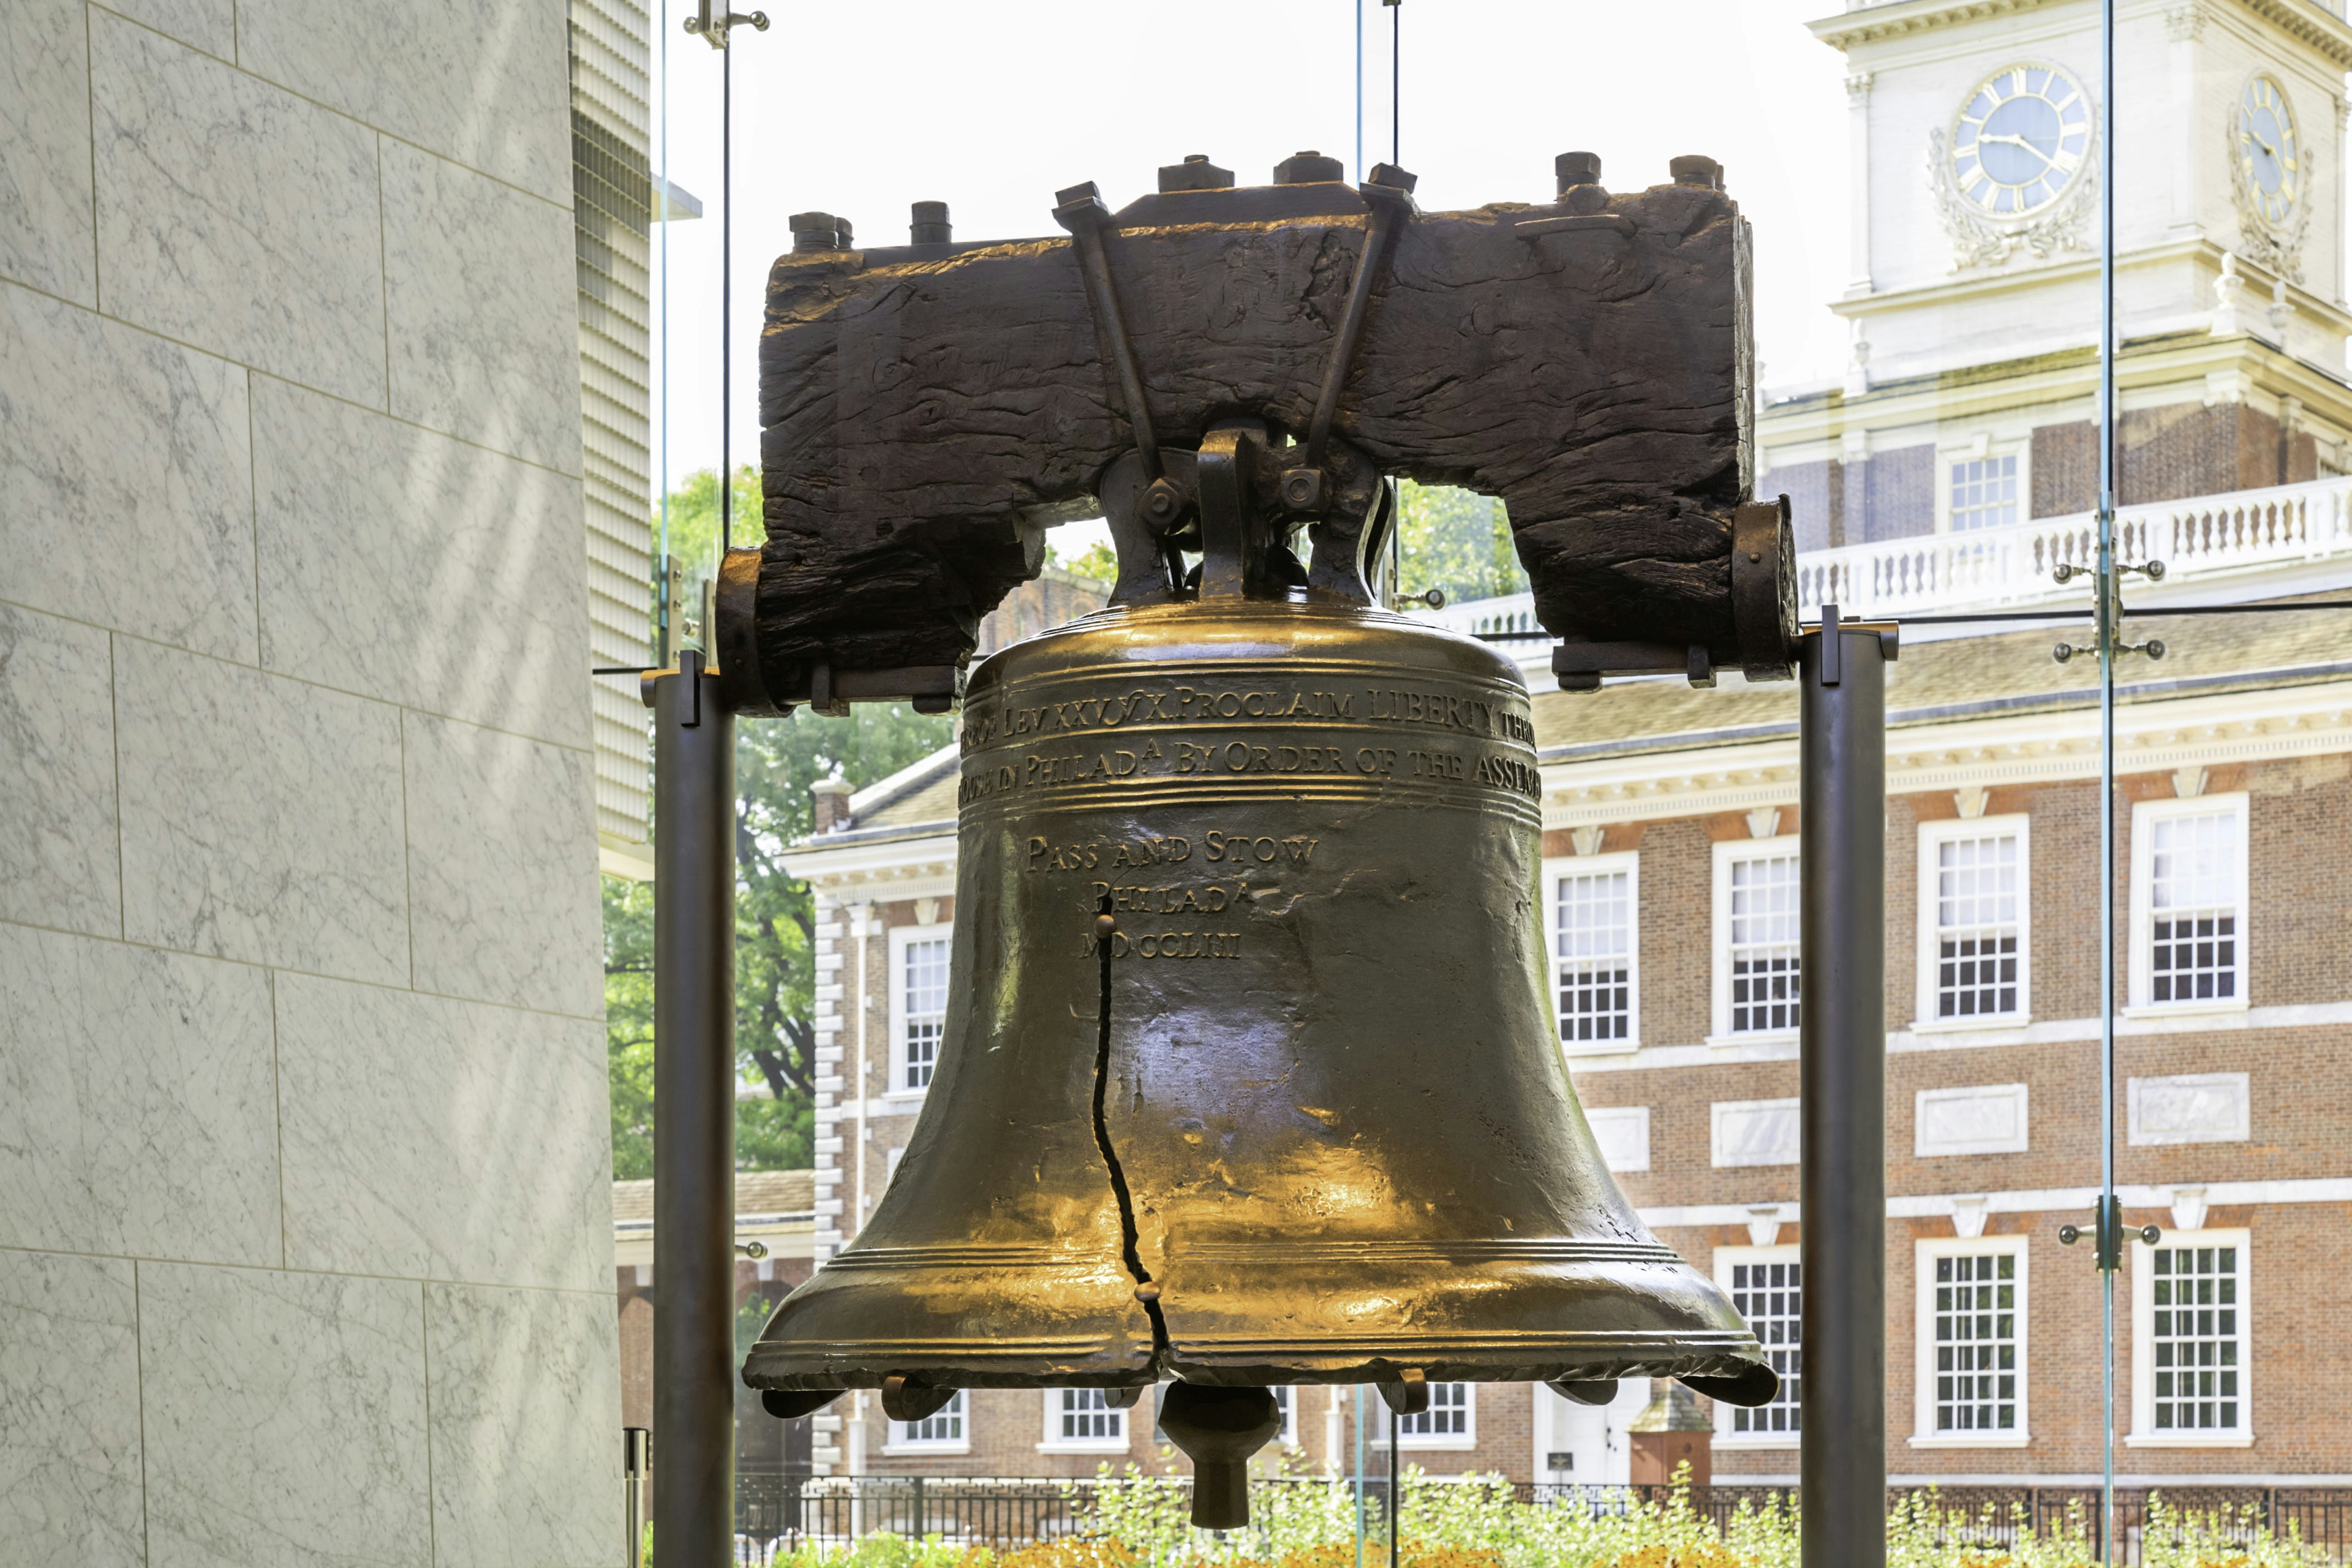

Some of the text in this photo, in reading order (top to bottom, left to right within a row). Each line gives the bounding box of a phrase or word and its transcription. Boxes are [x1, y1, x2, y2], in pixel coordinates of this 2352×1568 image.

[1174, 687, 1355, 720] PROCLAIM
[1367, 688, 1496, 737] LIBERTY
[998, 765, 1020, 792] IN
[1174, 742, 1218, 773] BY
[1223, 741, 1348, 773] ORDER
[1356, 747, 1398, 774] OF
[1407, 750, 1465, 780] THE
[1026, 831, 1319, 873] PASS AND STOW
